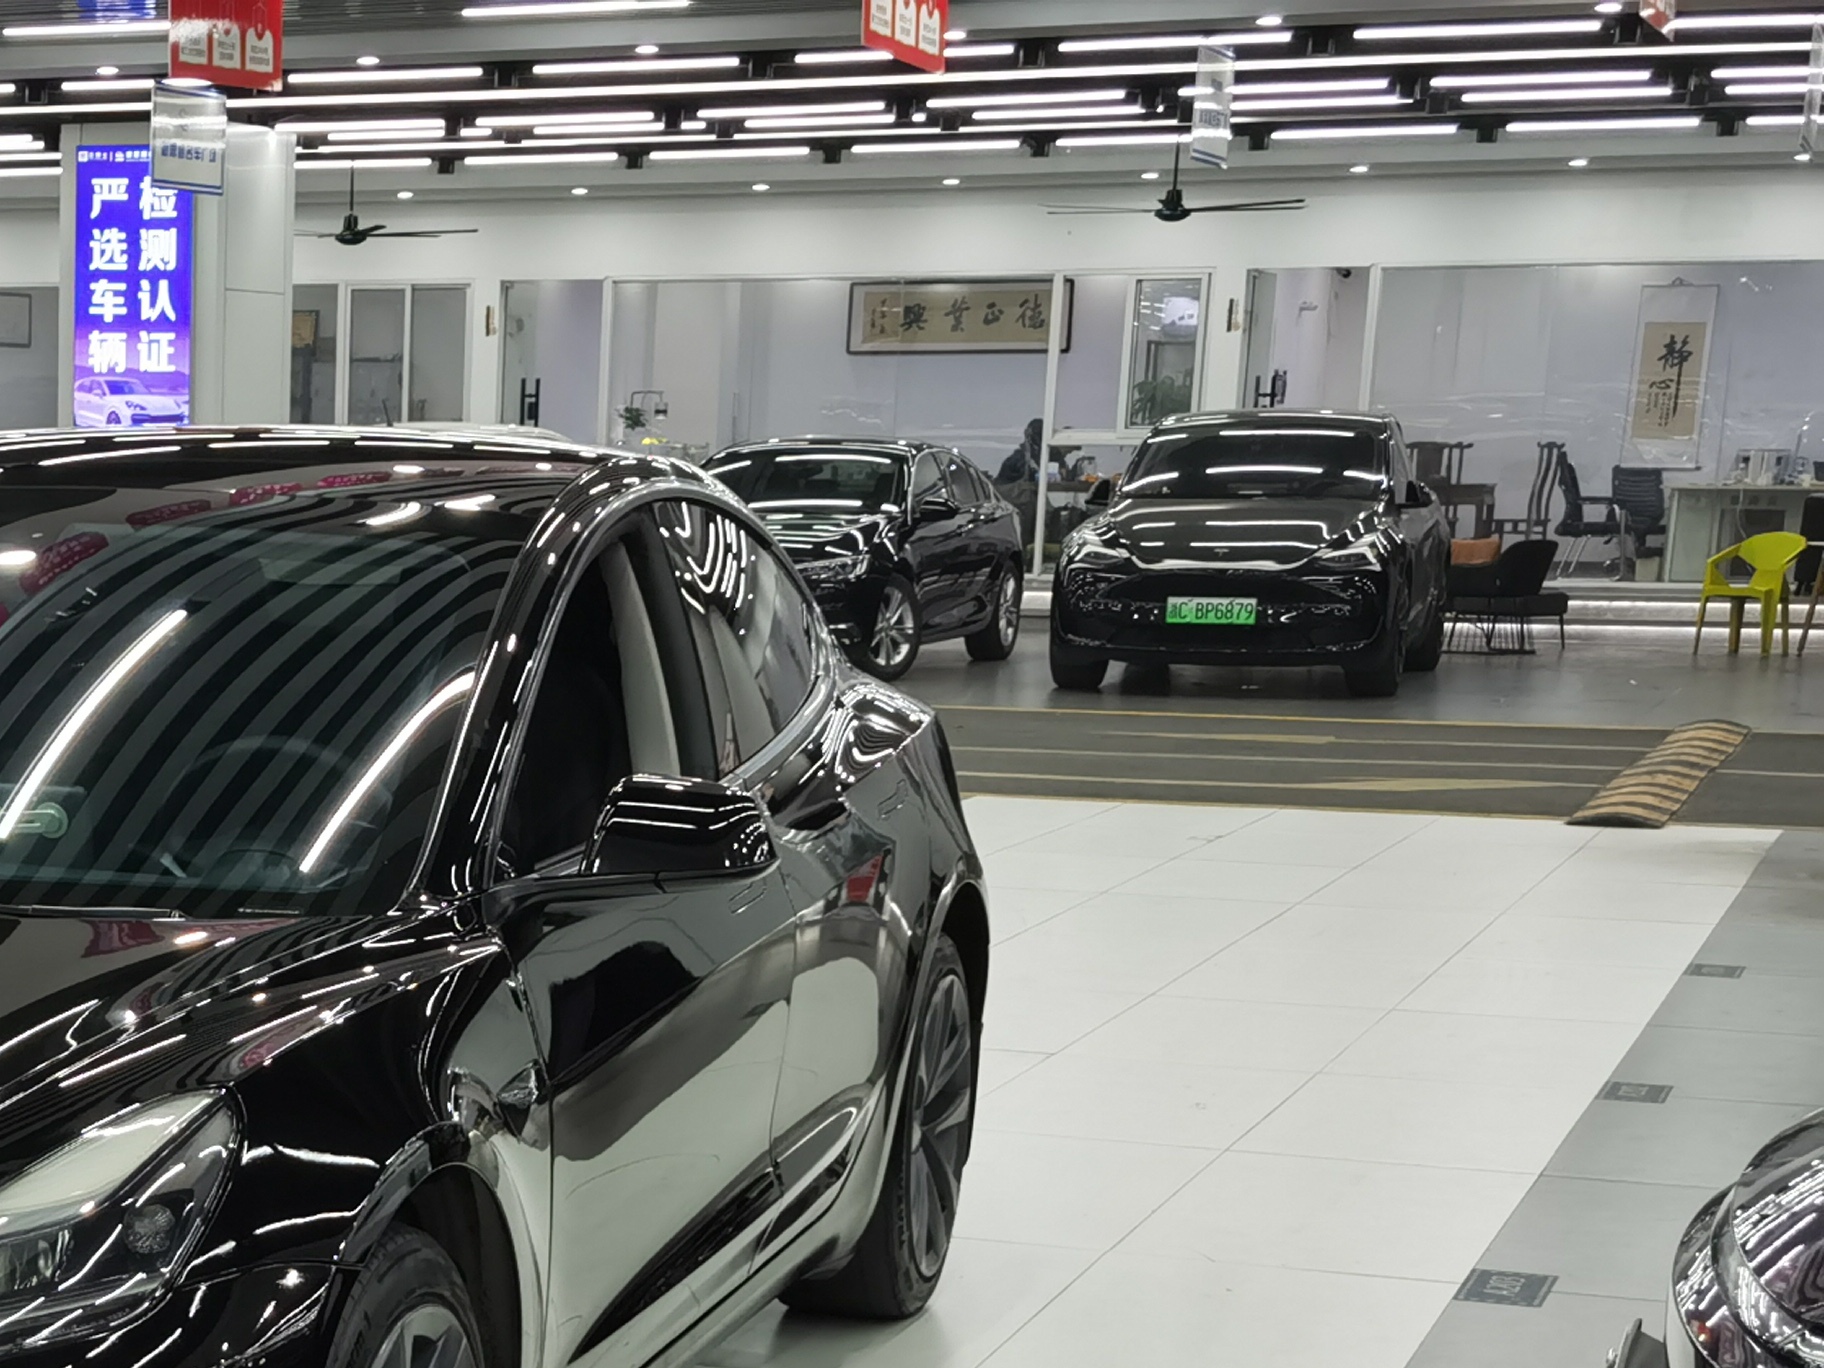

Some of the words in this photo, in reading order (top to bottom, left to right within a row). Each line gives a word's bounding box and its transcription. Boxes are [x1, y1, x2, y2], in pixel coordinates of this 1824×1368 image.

[89, 177, 129, 374] 严选车辆
[138, 175, 177, 374] 检测认证
[1195, 602, 1255, 621] BP6879
